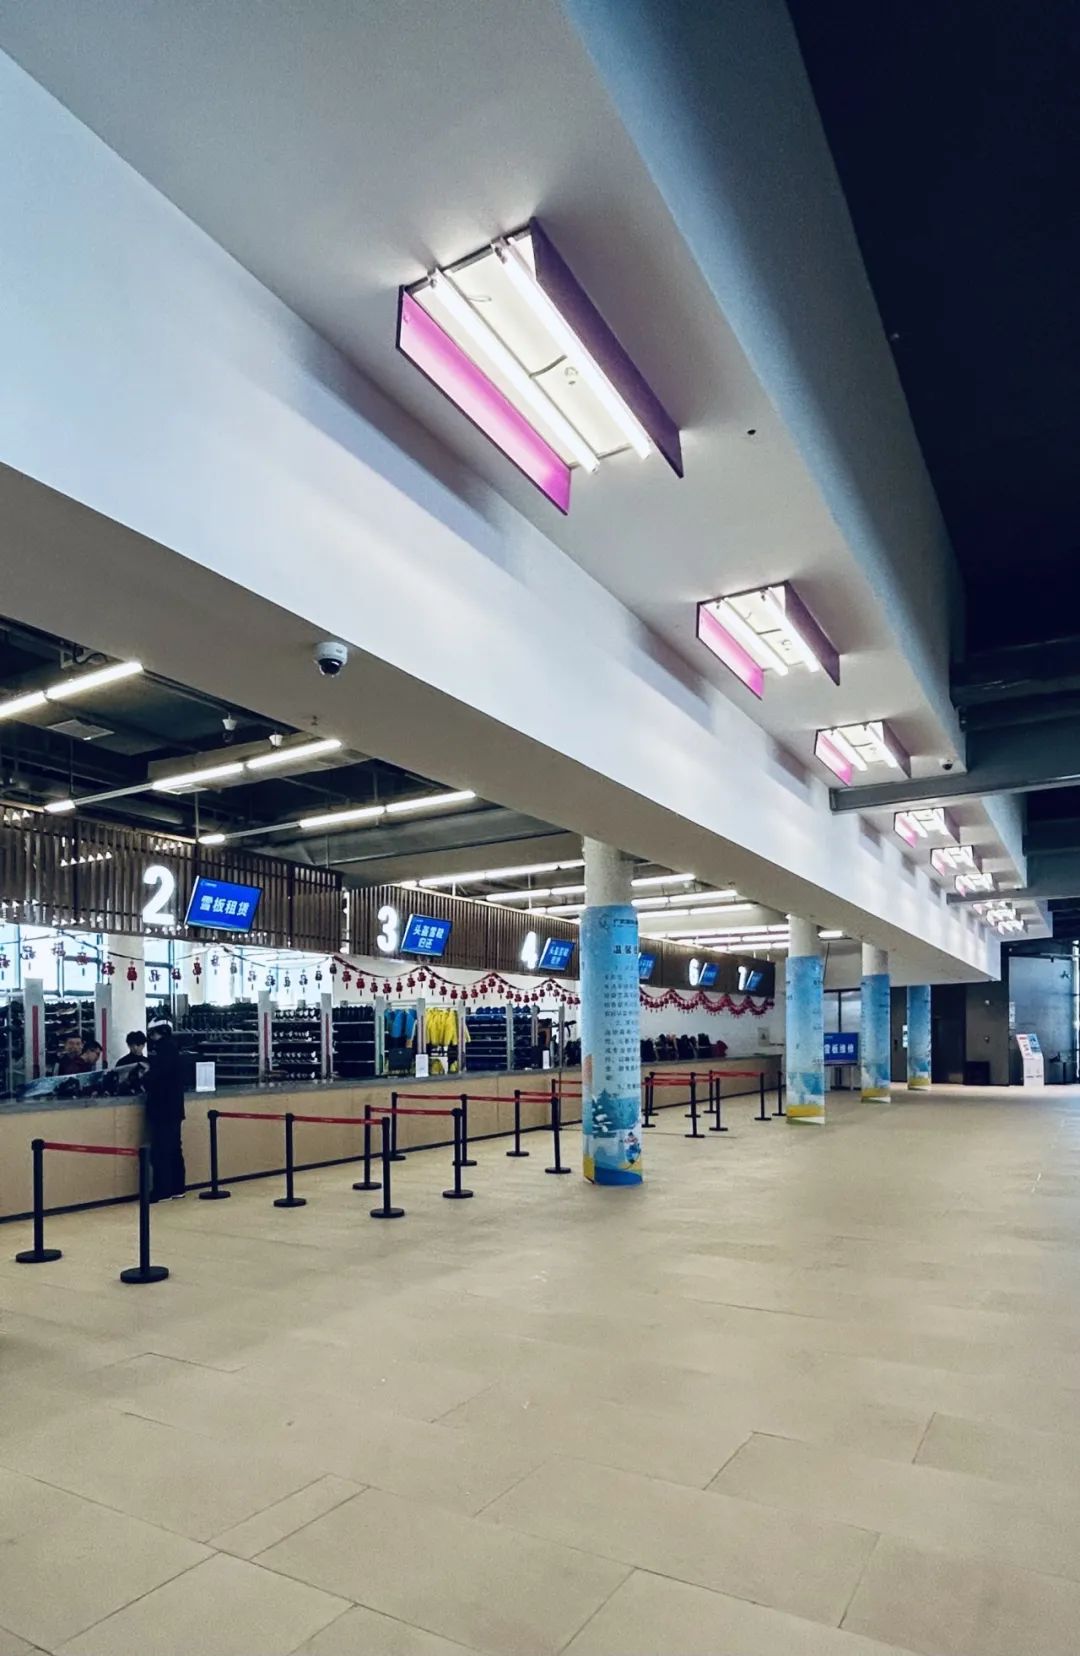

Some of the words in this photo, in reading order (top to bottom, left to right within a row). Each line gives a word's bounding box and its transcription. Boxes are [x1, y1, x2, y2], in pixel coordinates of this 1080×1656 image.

[142, 865, 175, 926] 2
[200, 895, 251, 917] 雪板租赁
[377, 905, 398, 952] 3
[521, 930, 538, 969] 4
[688, 958, 700, 986] 6
